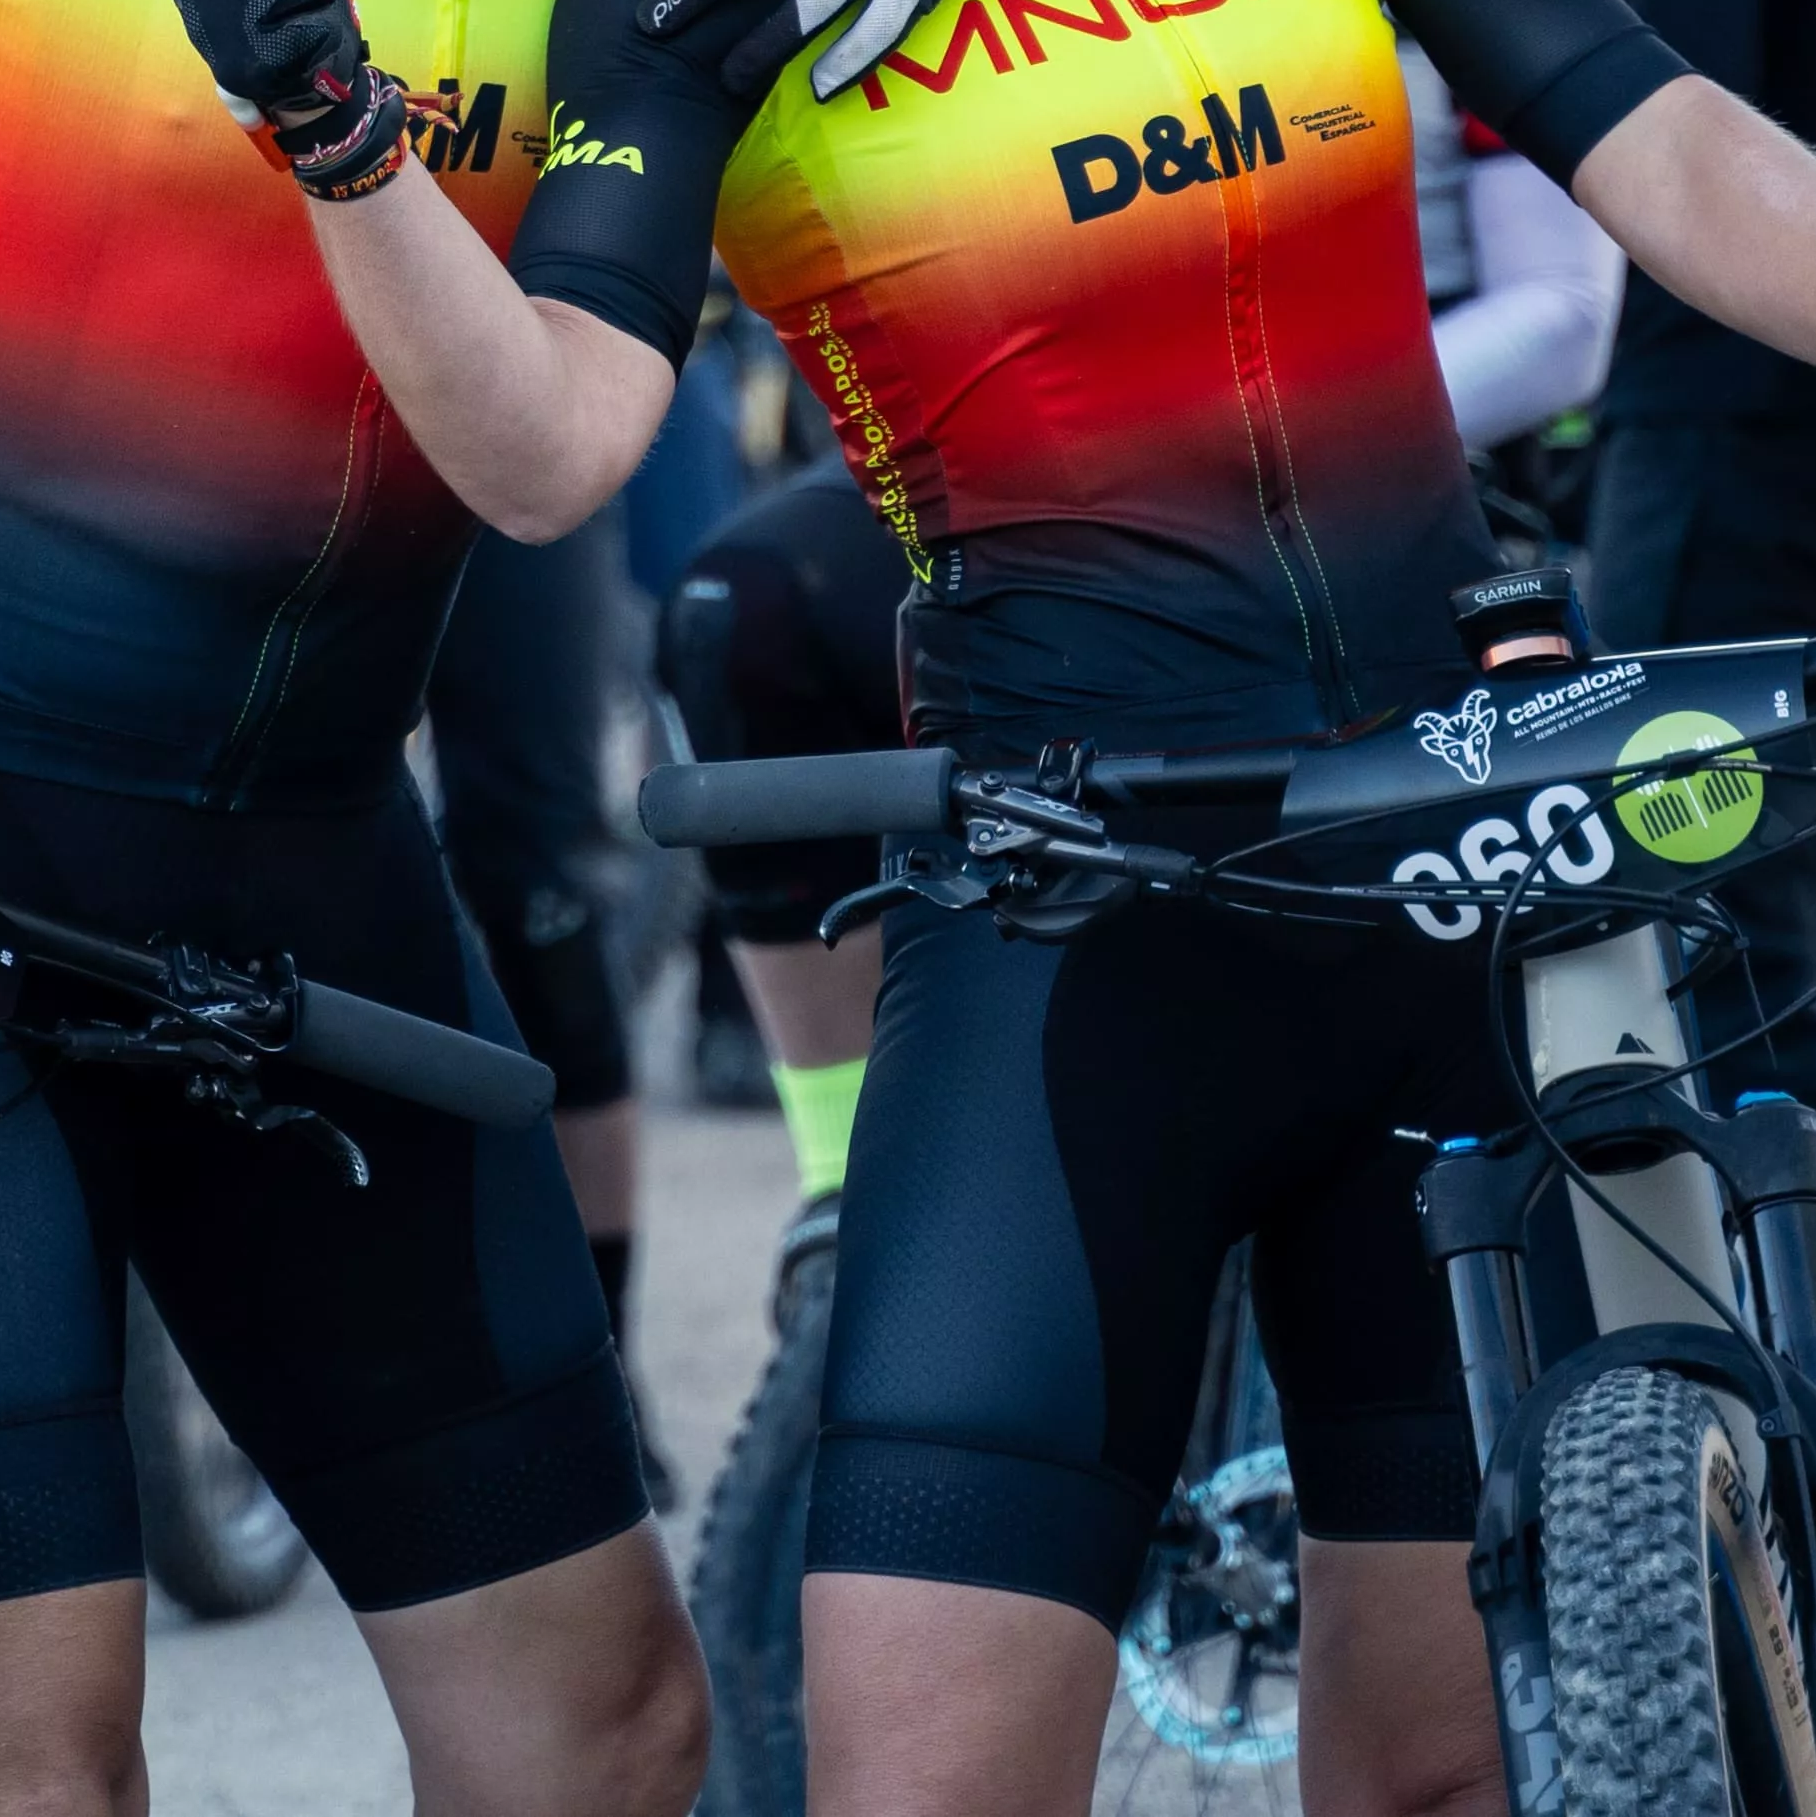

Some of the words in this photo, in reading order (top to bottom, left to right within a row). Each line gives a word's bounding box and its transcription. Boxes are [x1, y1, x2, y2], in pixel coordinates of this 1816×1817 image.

[1051, 84, 1286, 224] D&M
[1475, 580, 1541, 603] GARMIN
[1559, 721, 1569, 731] DE
[1570, 715, 1584, 727] LOS
[1585, 700, 1614, 720] MALLOS
[1392, 784, 1615, 941] 060
